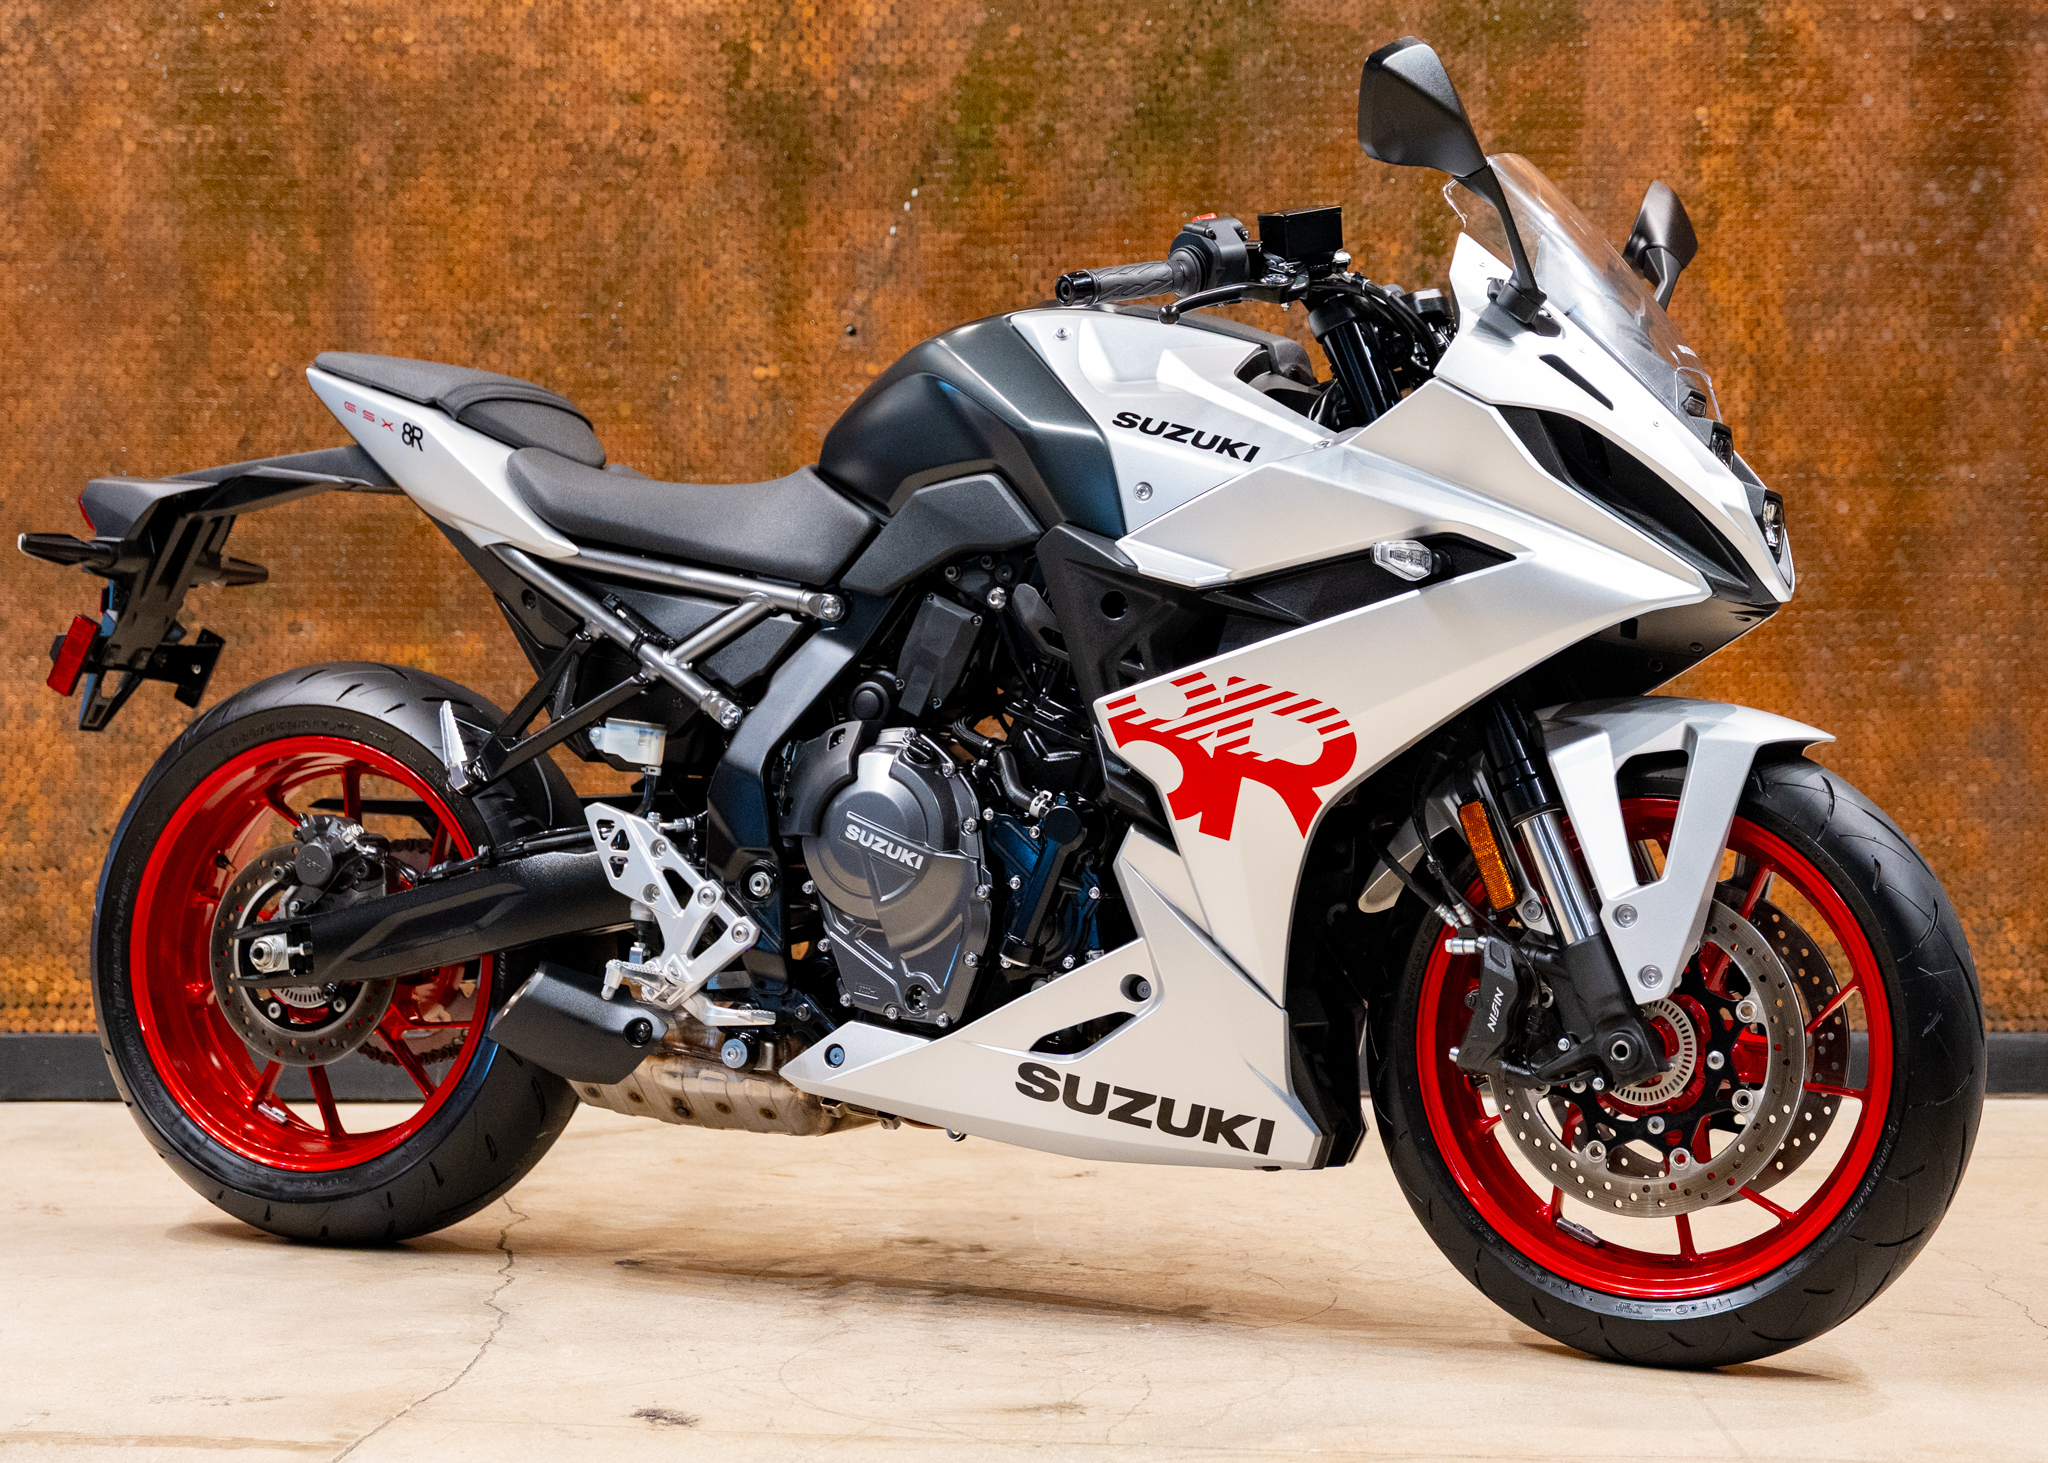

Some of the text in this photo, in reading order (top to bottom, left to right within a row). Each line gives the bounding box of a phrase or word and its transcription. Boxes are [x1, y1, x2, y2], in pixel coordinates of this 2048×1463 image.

[401, 422, 424, 452] 8R
[1112, 411, 1261, 463] SUZUKI
[844, 823, 924, 870] SUZUKI
[1487, 986, 1504, 1033] NISSIN
[1015, 1061, 1276, 1156] SUZUKI
